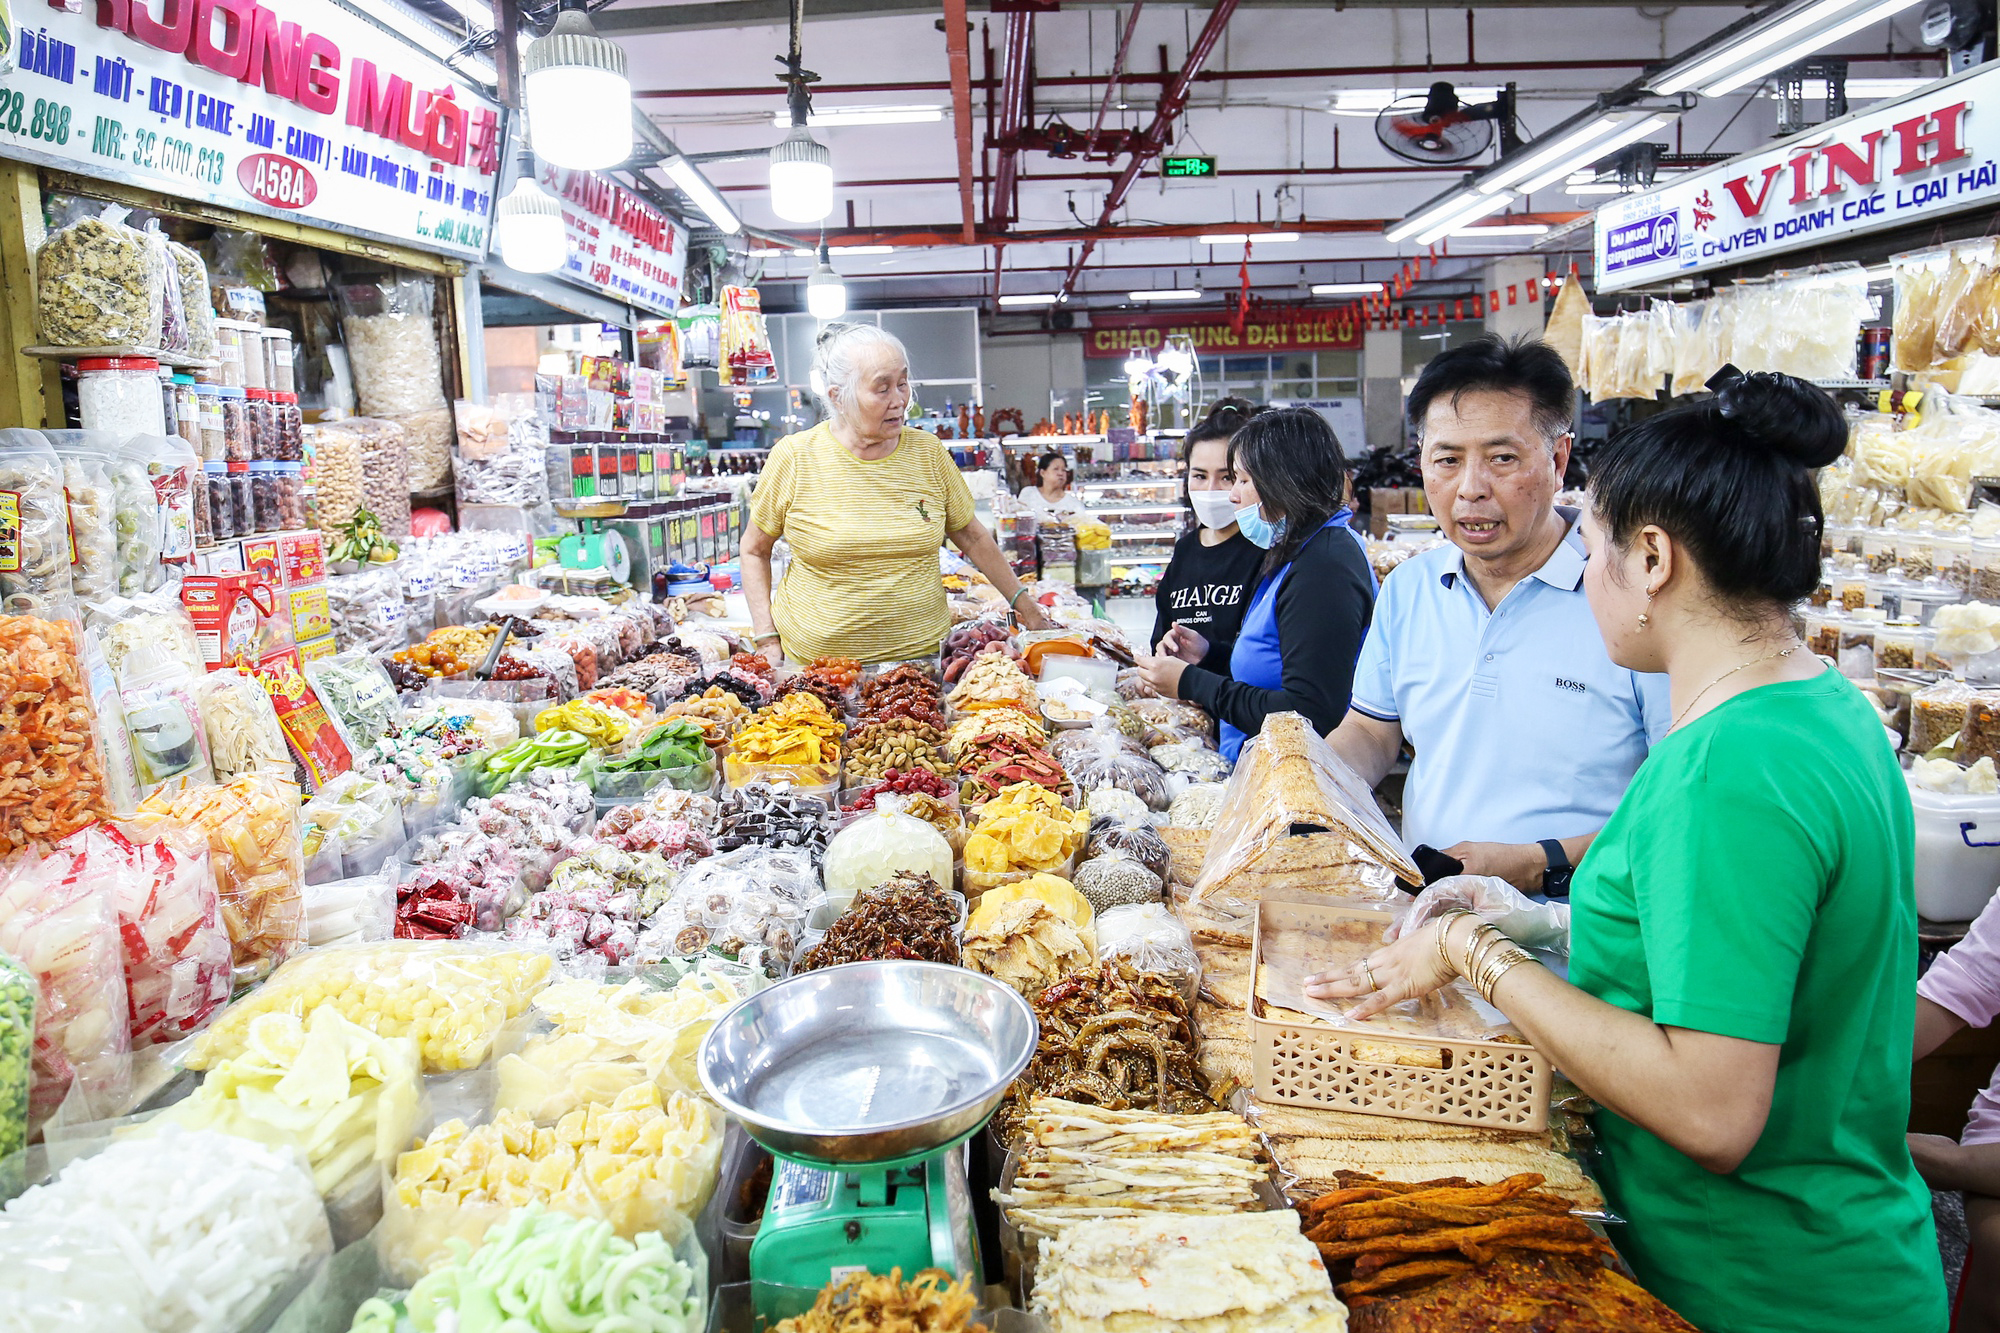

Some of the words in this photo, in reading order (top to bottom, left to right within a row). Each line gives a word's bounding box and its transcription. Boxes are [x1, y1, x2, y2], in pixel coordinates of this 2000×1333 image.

[19, 27, 76, 84] BÁNH
[149, 76, 183, 123] KẸO
[196, 94, 235, 136] CAKE
[246, 112, 275, 149] JAM
[285, 126, 325, 164] CANDY
[92, 116, 129, 160] NR:
[252, 157, 305, 206] A58A
[1774, 207, 1835, 240] DOANH
[1842, 189, 1885, 222] CÁC
[1958, 160, 1997, 194] HẢI
[1246, 323, 1288, 349] ĐẠI
[1555, 677, 1586, 691] BOSS
